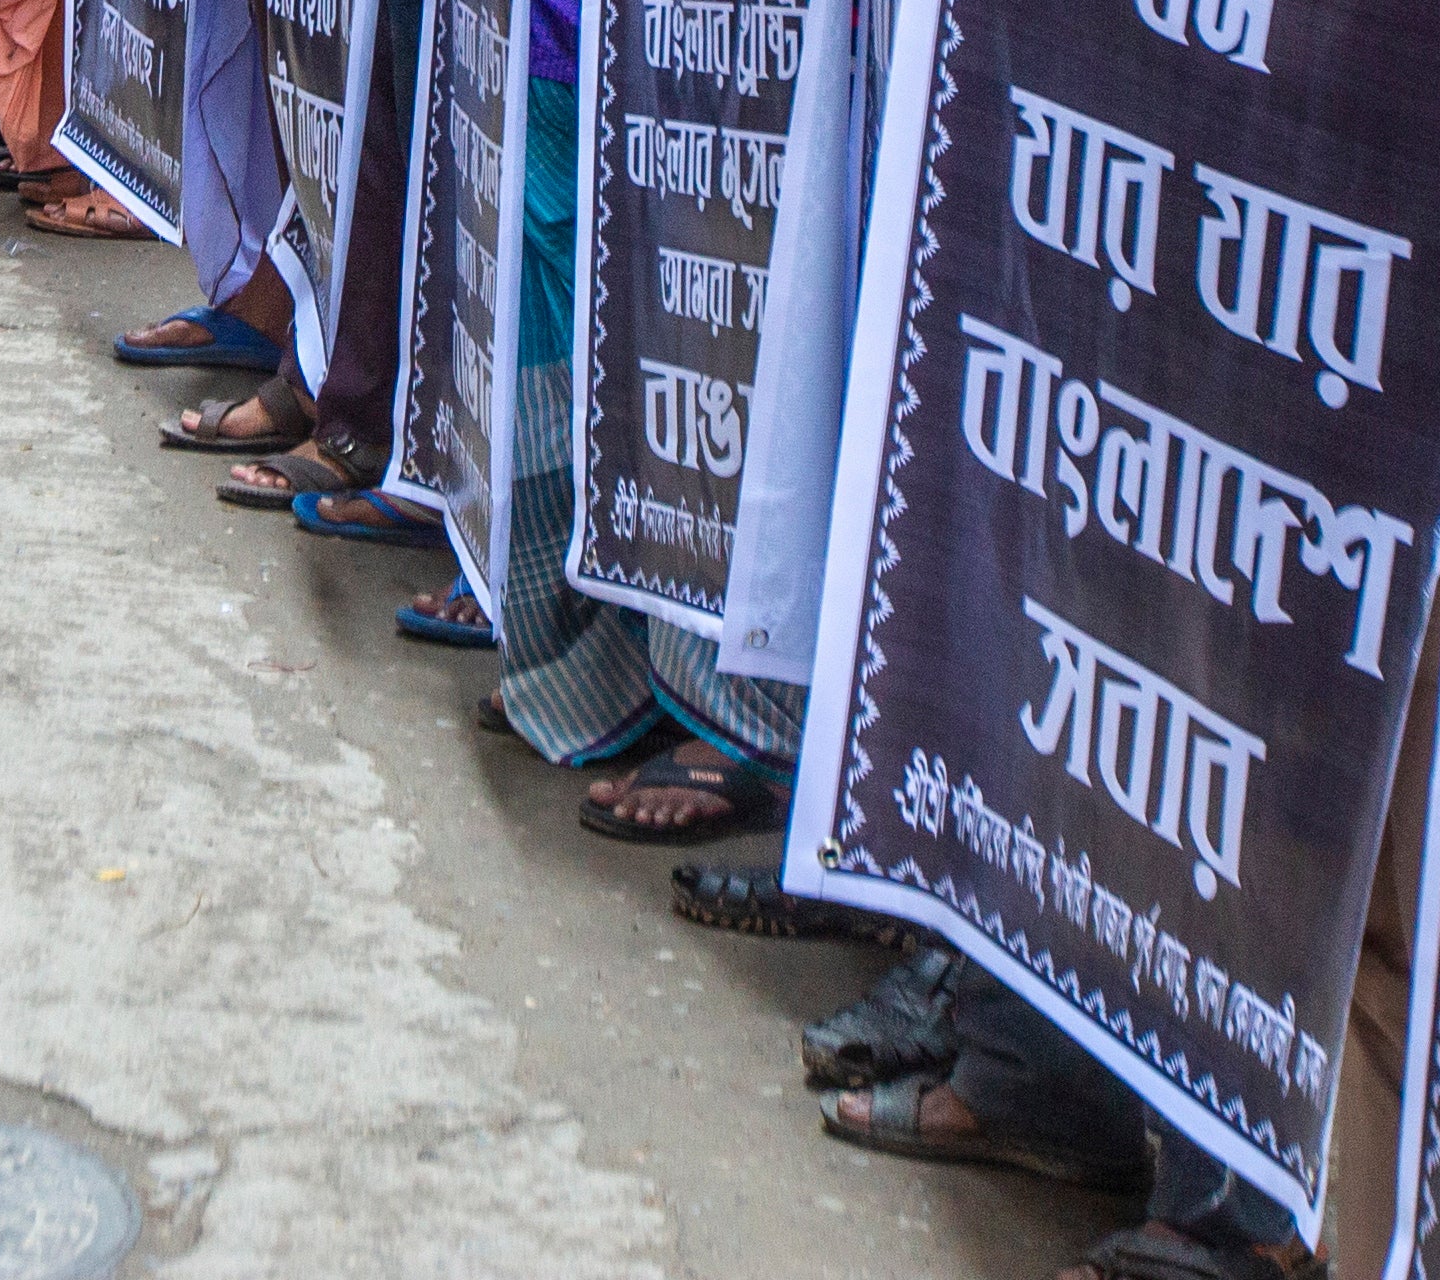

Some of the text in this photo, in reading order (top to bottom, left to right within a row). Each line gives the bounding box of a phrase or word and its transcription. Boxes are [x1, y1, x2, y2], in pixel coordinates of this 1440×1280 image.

[625, 112, 718, 203] বাংলার
[1010, 86, 1414, 410] যার যার
[659, 245, 735, 331] আমরা
[961, 314, 1414, 682] বাংলাদেশ
[894, 747, 949, 838] শ্রীশ্রী
[1051, 839, 1092, 936] শাঁখারী
[1020, 595, 1267, 903] সবার
